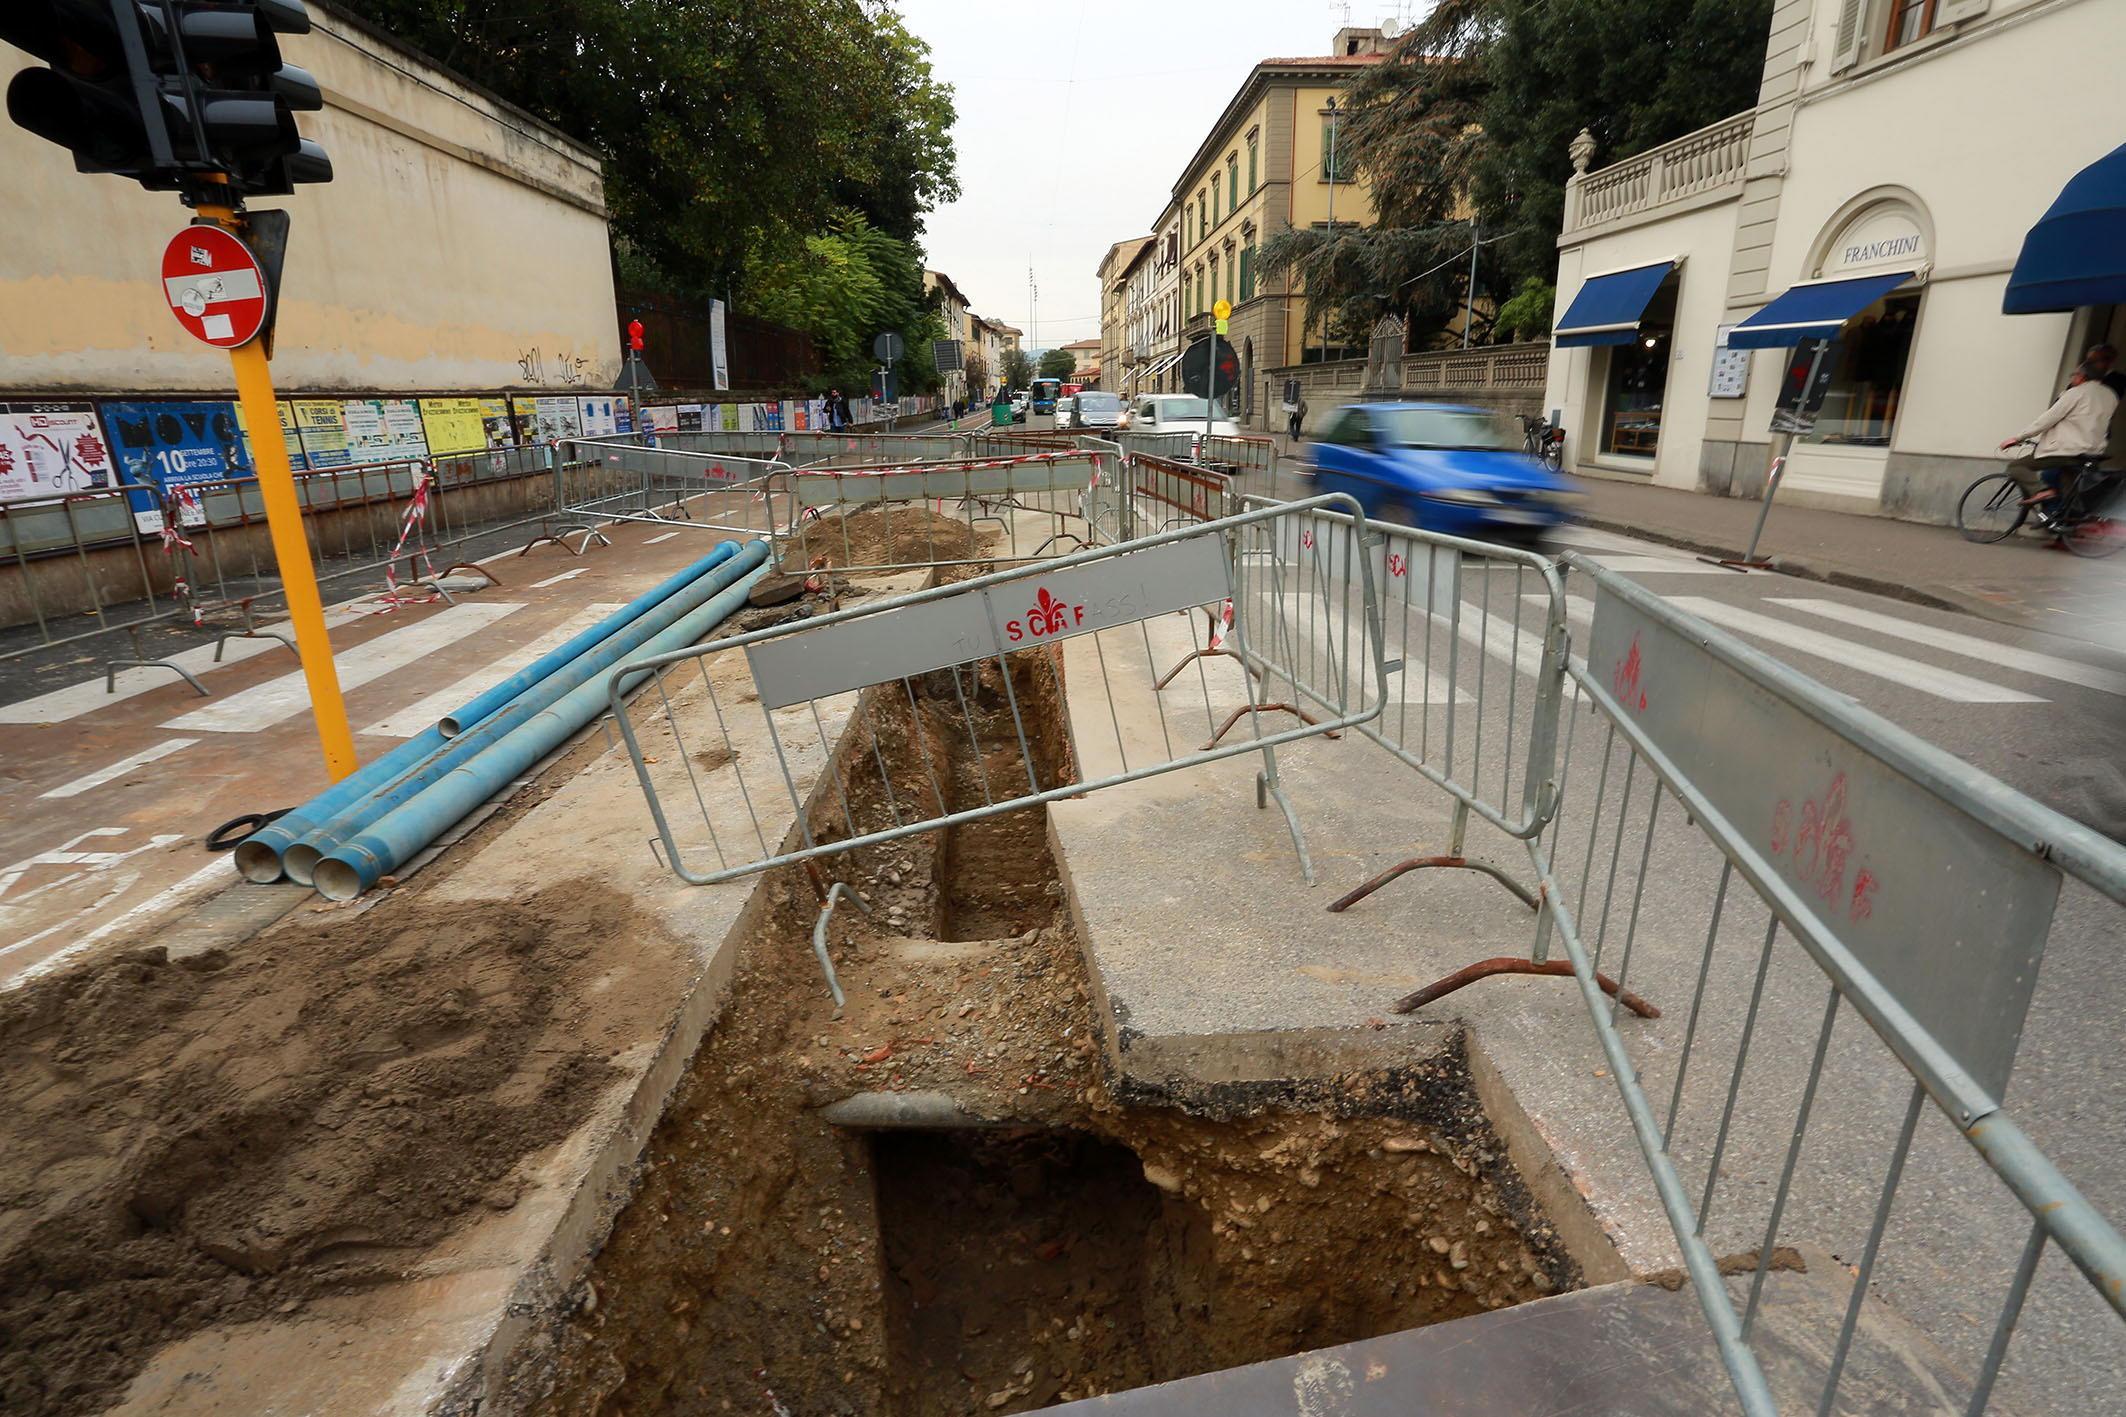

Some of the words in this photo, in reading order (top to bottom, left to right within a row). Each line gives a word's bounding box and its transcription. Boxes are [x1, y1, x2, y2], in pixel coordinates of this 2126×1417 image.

[1844, 235, 1919, 264] FRANCHINI
[311, 415, 338, 424] TENNIS
[157, 449, 187, 474] 10
[180, 448, 215, 456] SETTEMBRE
